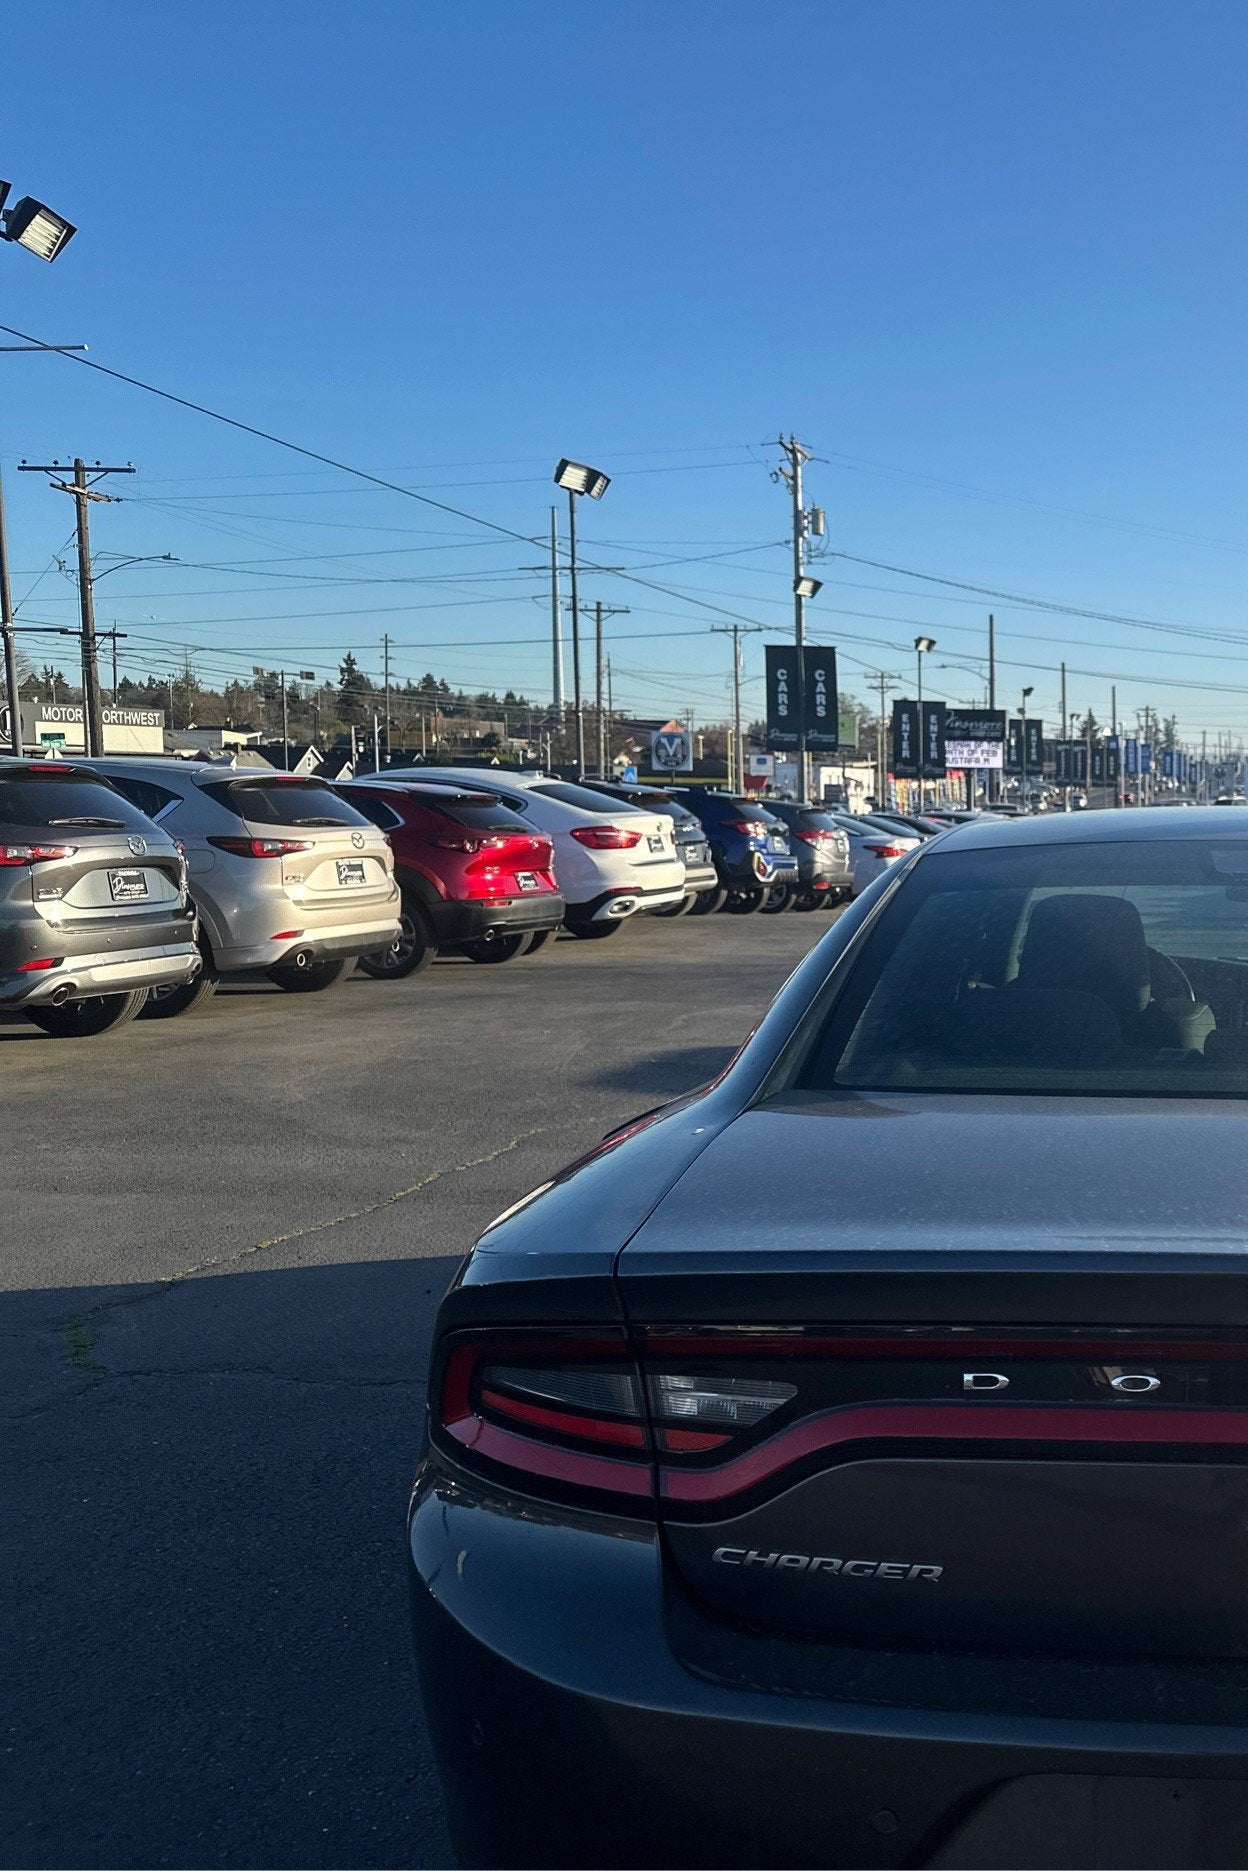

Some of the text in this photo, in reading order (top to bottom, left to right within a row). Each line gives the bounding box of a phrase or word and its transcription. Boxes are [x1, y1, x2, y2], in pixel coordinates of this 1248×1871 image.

[777, 668, 788, 717] CARS
[815, 669, 827, 718] CARS
[41, 706, 161, 726] MOTOR ORTHWEST
[902, 713, 910, 758] ENTER
[930, 714, 938, 759] ENTER
[711, 1547, 944, 1583] CHARGER
